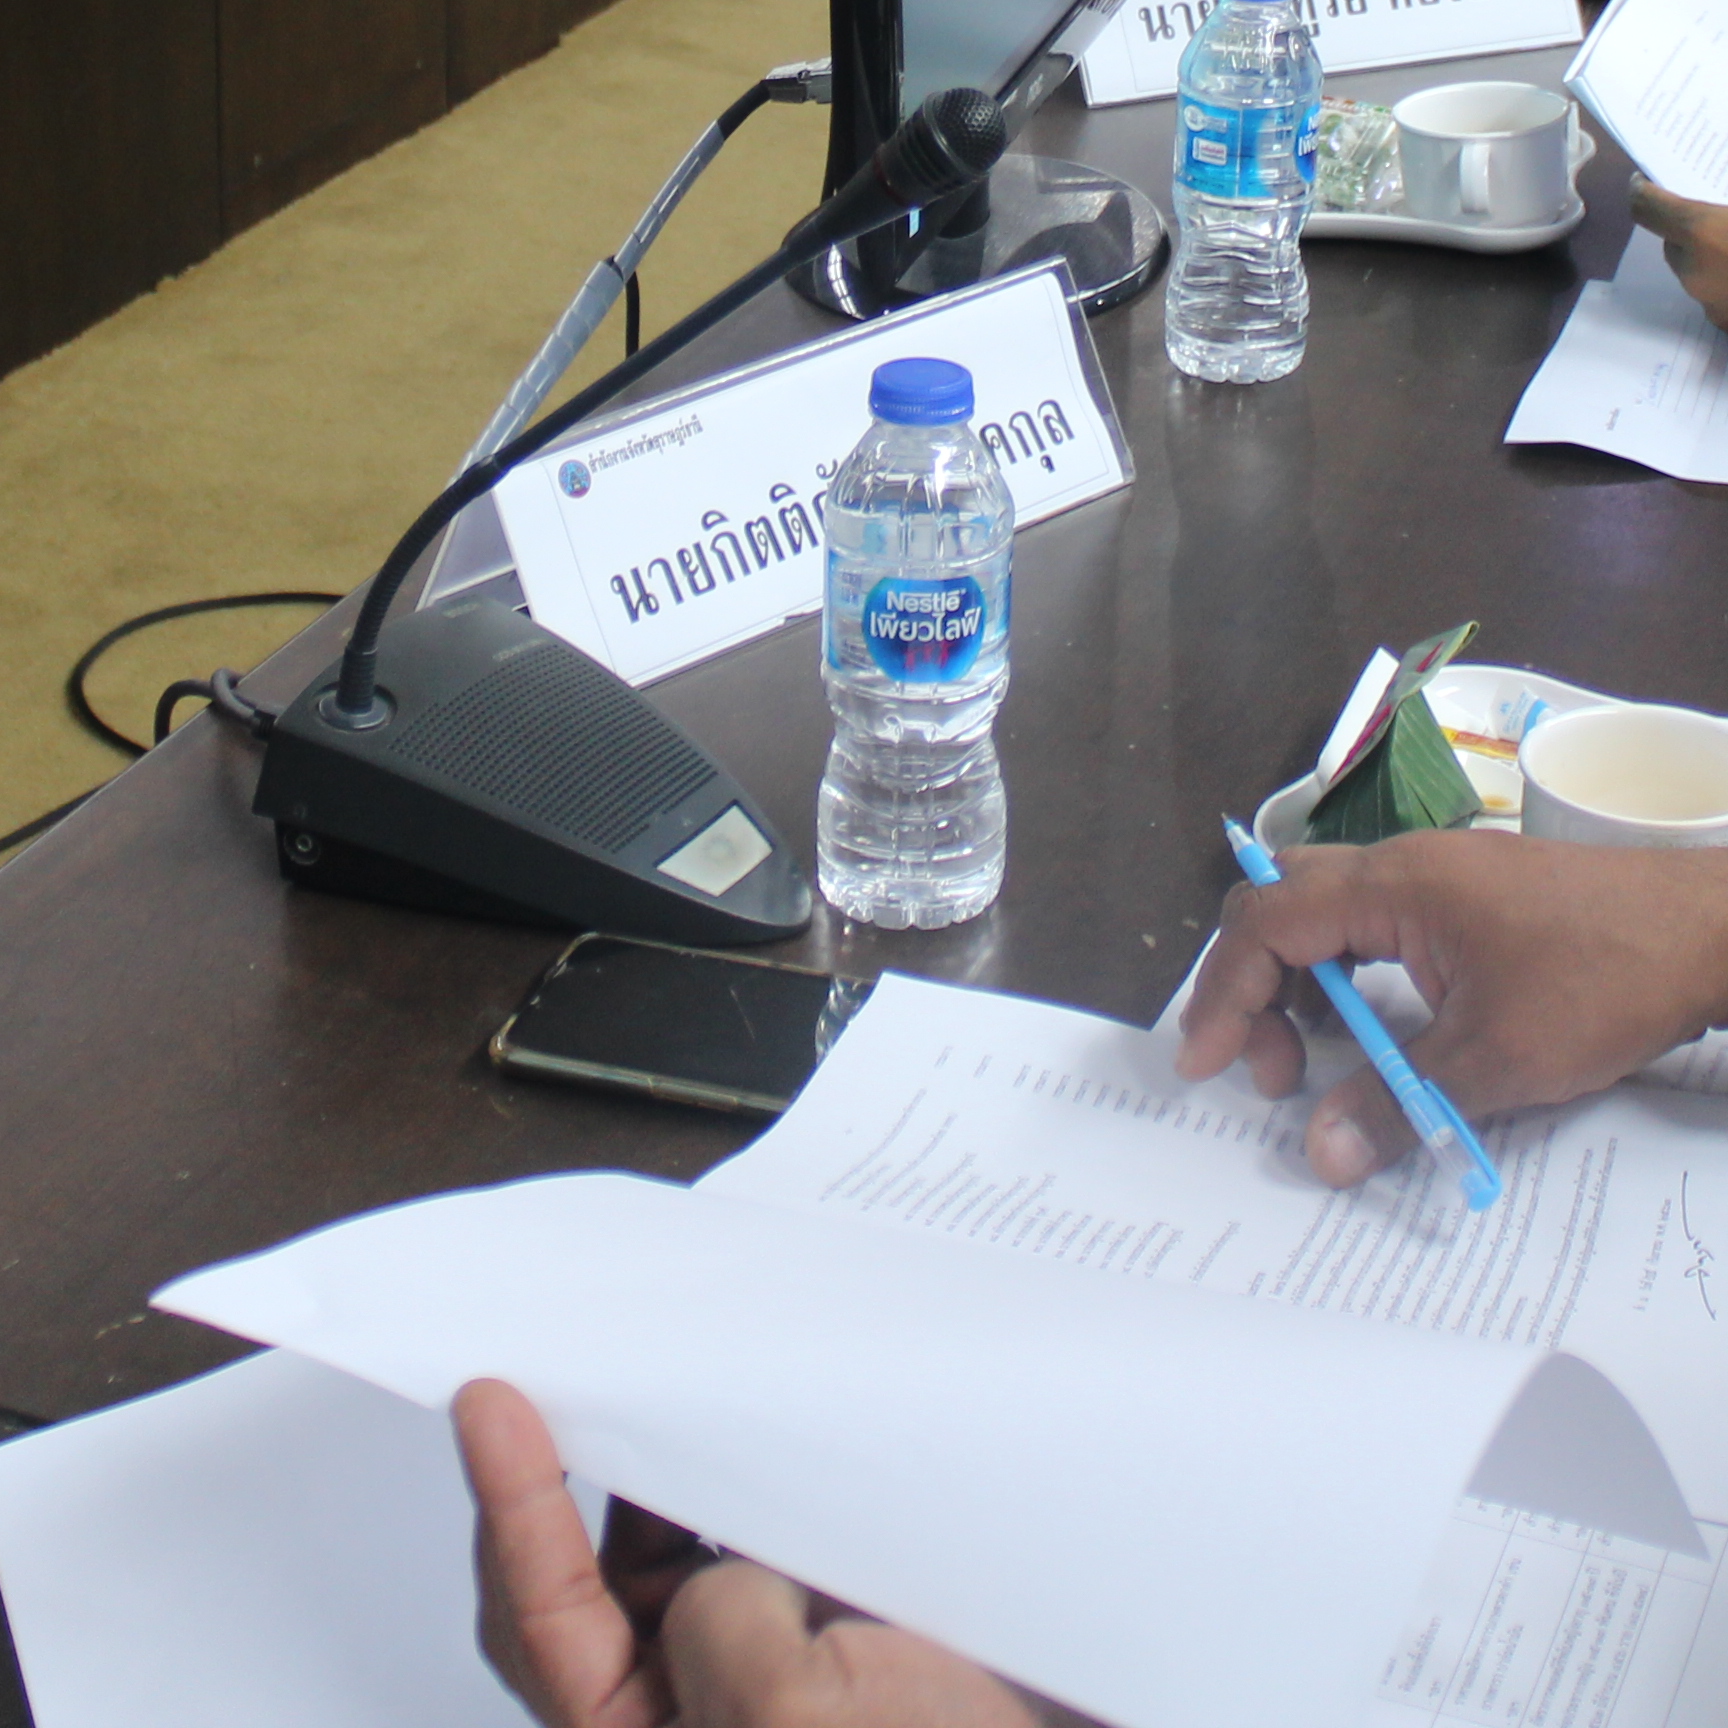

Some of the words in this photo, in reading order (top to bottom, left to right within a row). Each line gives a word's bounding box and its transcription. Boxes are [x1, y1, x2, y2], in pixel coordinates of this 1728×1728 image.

[886, 587, 967, 614] Nestlé
[870, 606, 982, 643] เพียวไลฟ์
